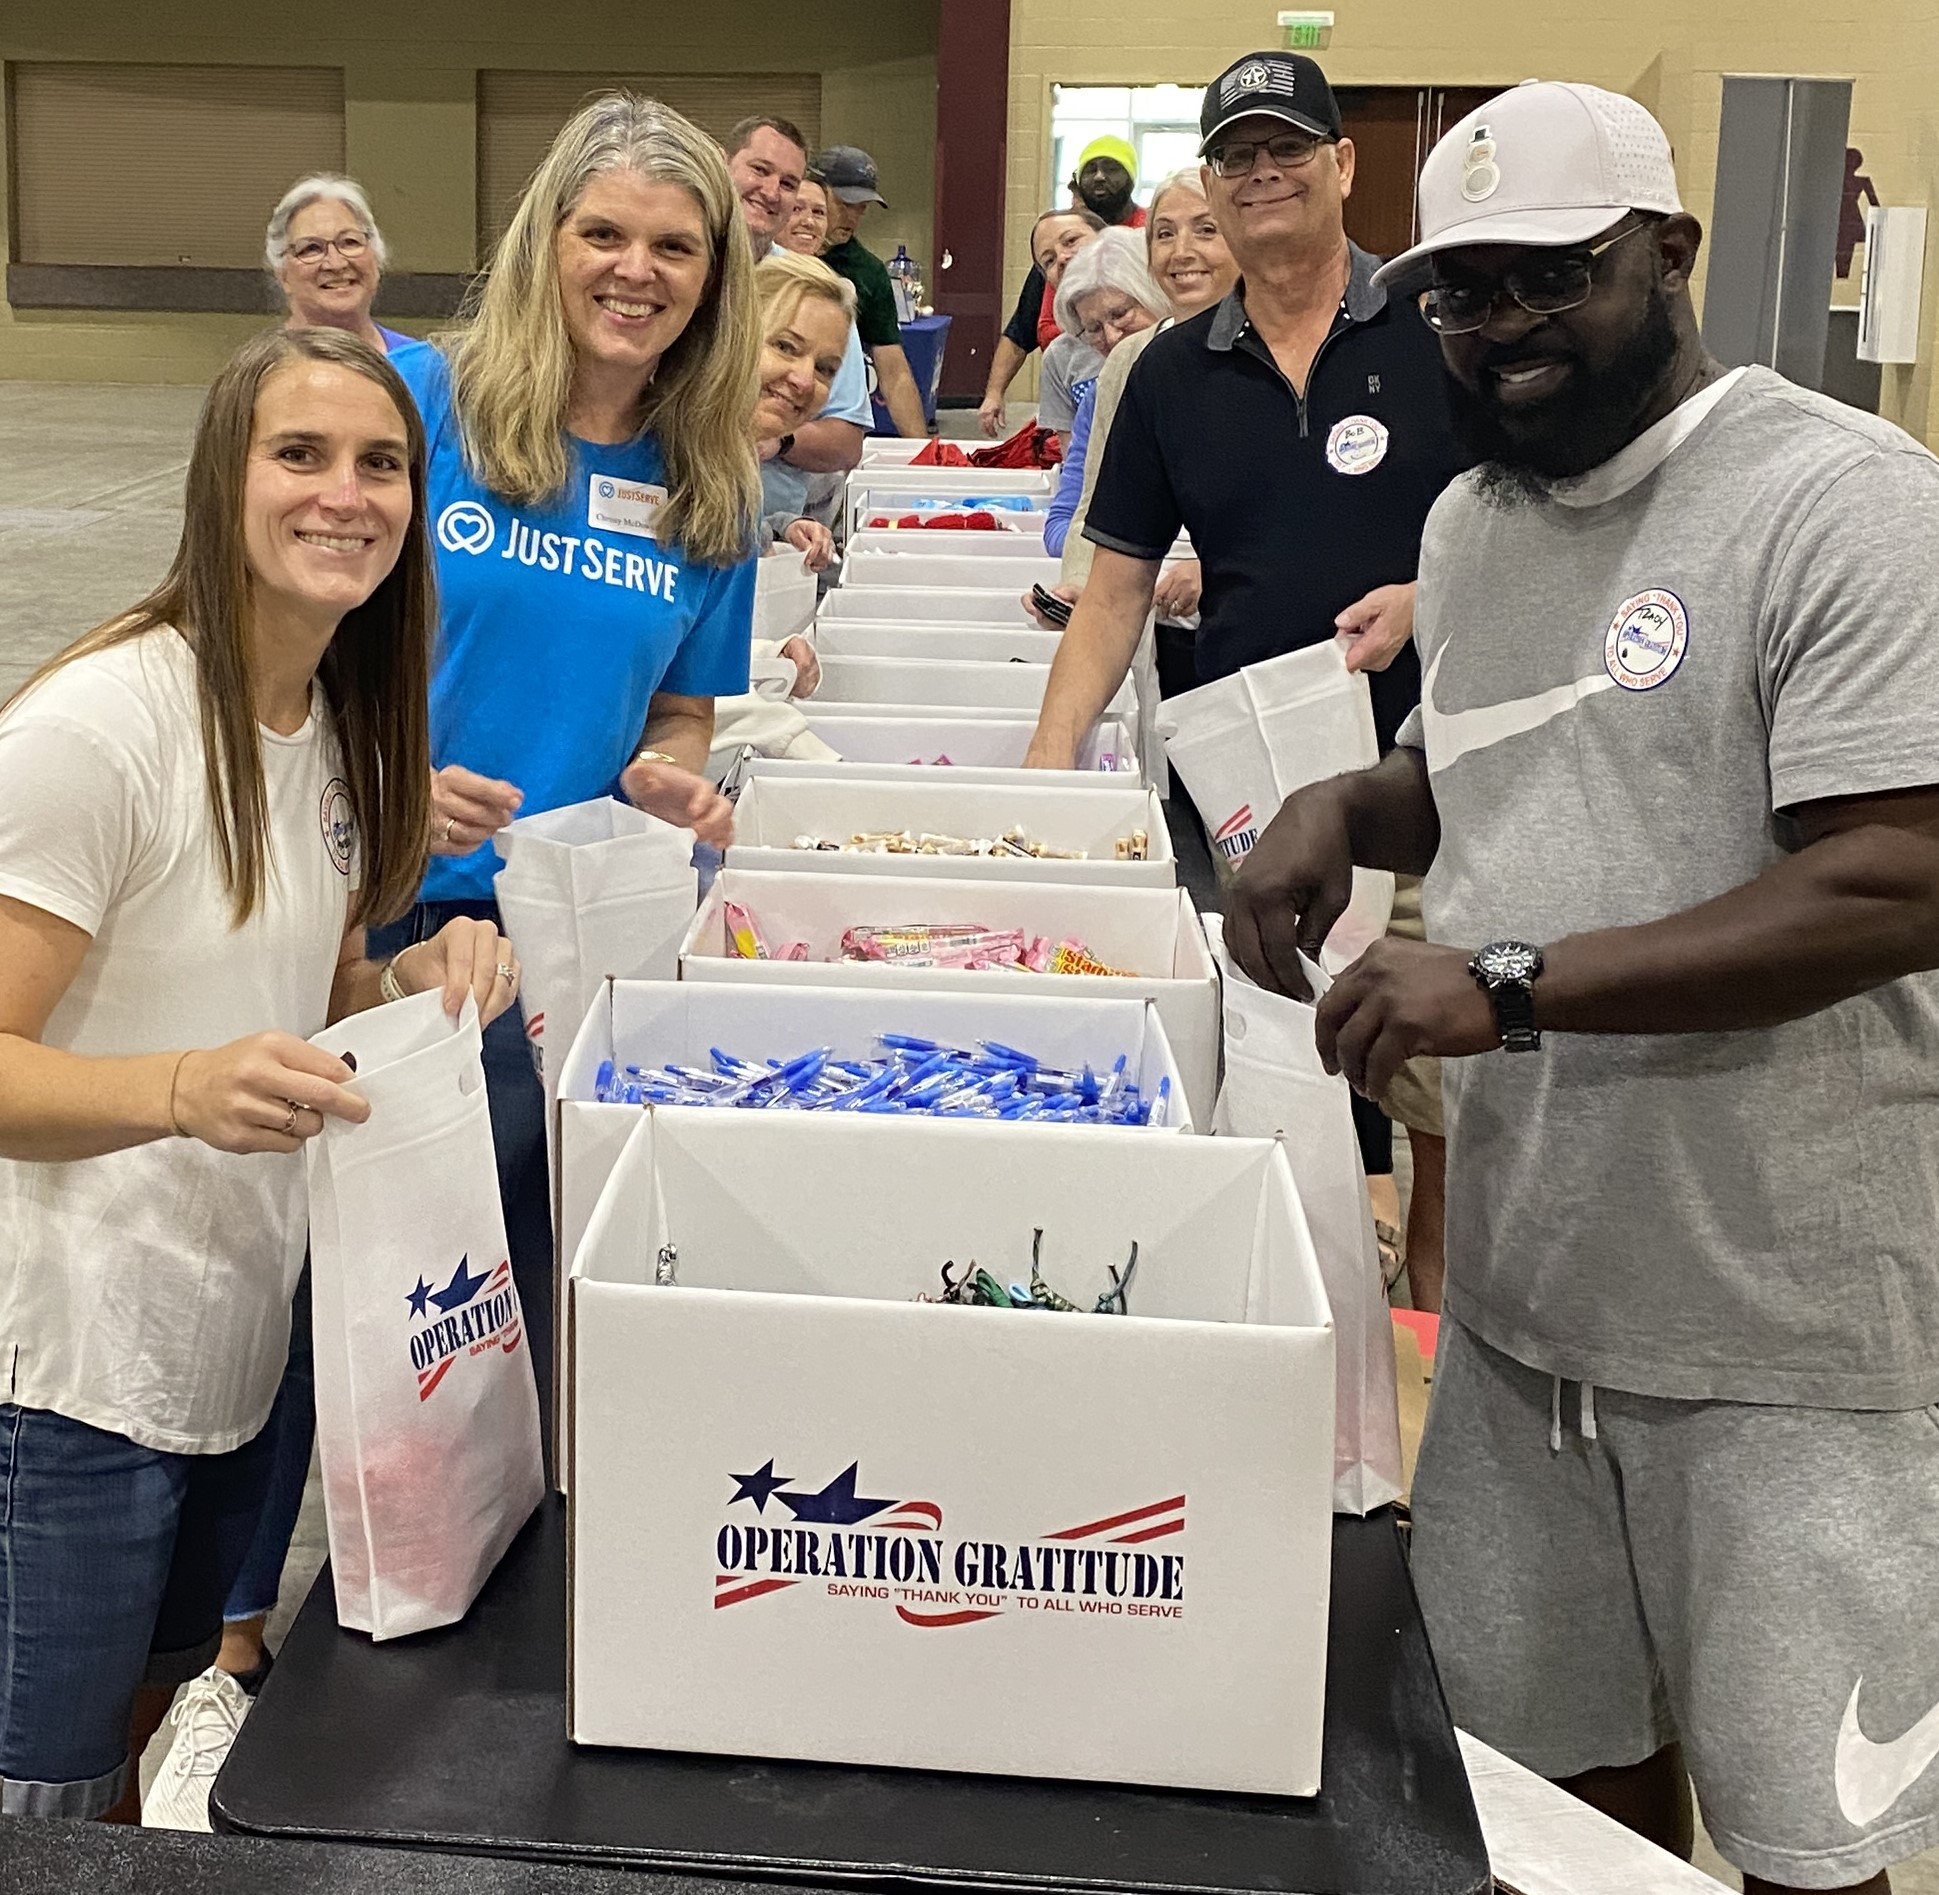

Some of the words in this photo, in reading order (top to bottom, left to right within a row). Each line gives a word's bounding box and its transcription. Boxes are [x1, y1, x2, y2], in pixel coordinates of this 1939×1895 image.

[1290, 24, 1319, 46] EXIT
[1620, 593, 1650, 619] SAYING
[1606, 645, 1615, 658] TO
[1608, 659, 1619, 677] ALL
[1640, 666, 1668, 687] SERVE
[1619, 674, 1638, 687] WHO
[410, 1285, 513, 1370] OPERATION
[716, 1523, 944, 1584] OPERATION
[954, 1541, 1184, 1601] GRATITUDE
[827, 1583, 890, 1599] SAYING
[1016, 1596, 1039, 1610] TO
[1043, 1598, 1075, 1612] ALL
[1079, 1600, 1122, 1615] WHO
[1127, 1603, 1184, 1619] SERVE
